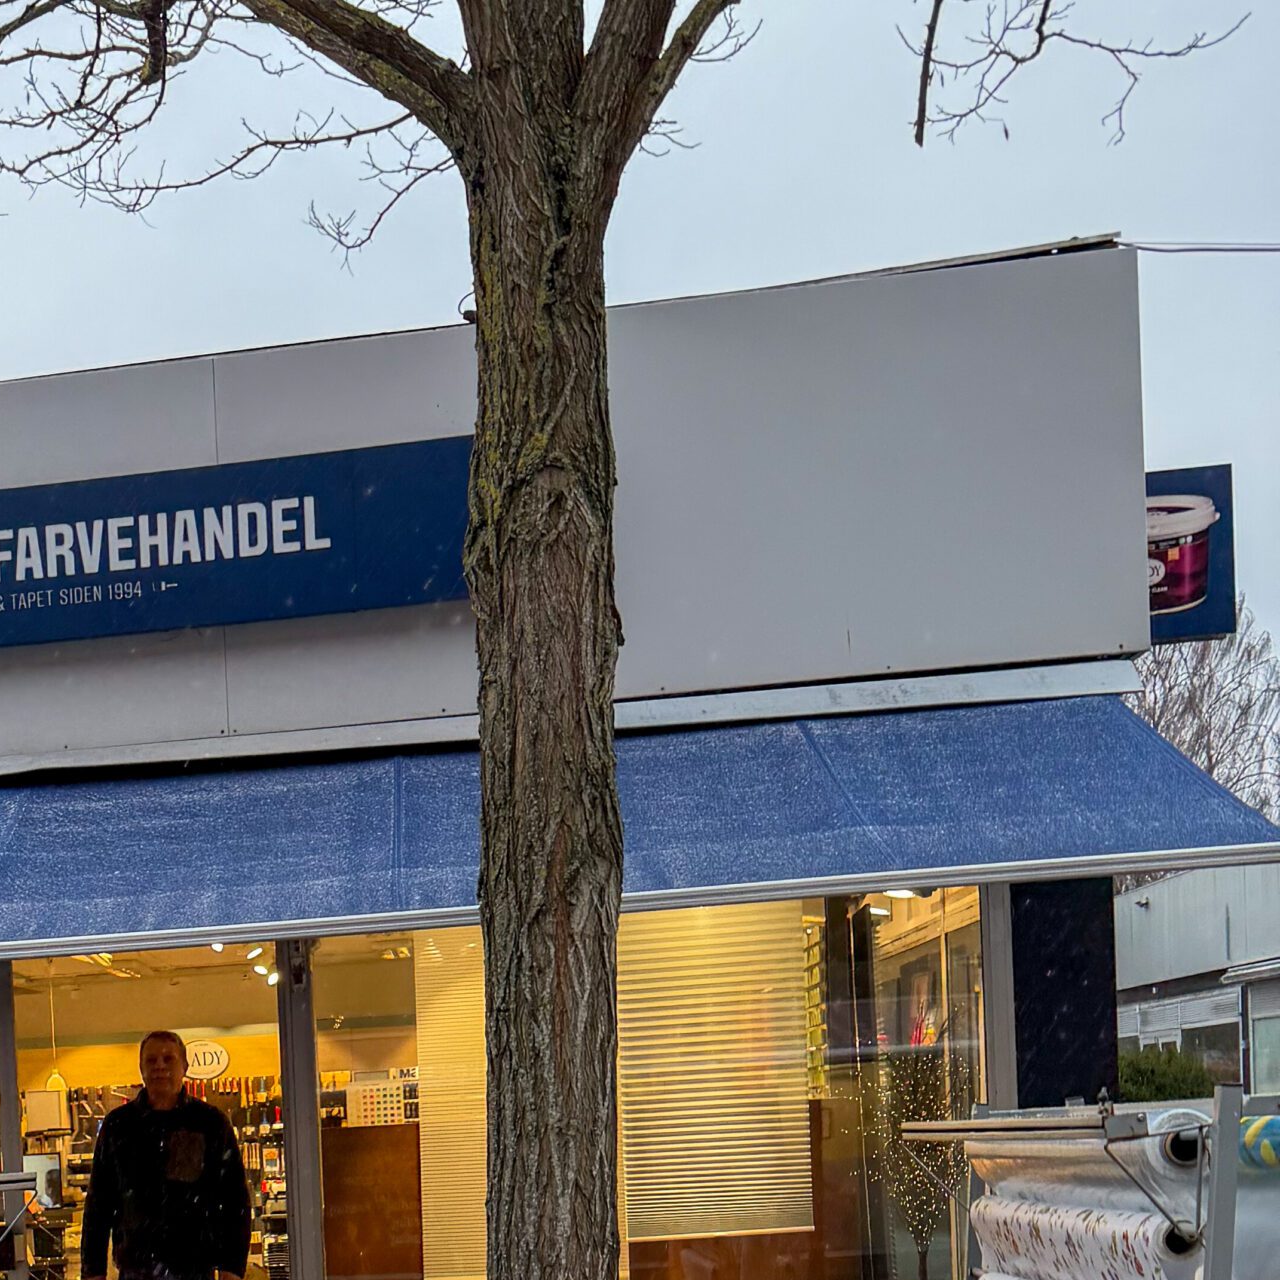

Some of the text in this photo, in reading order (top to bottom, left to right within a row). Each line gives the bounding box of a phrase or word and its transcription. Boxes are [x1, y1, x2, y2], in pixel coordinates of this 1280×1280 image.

[10, 589, 55, 610] TAPET
[59, 585, 102, 606] SIDEN
[108, 581, 142, 600] 1994
[191, 1050, 223, 1068] ADY
